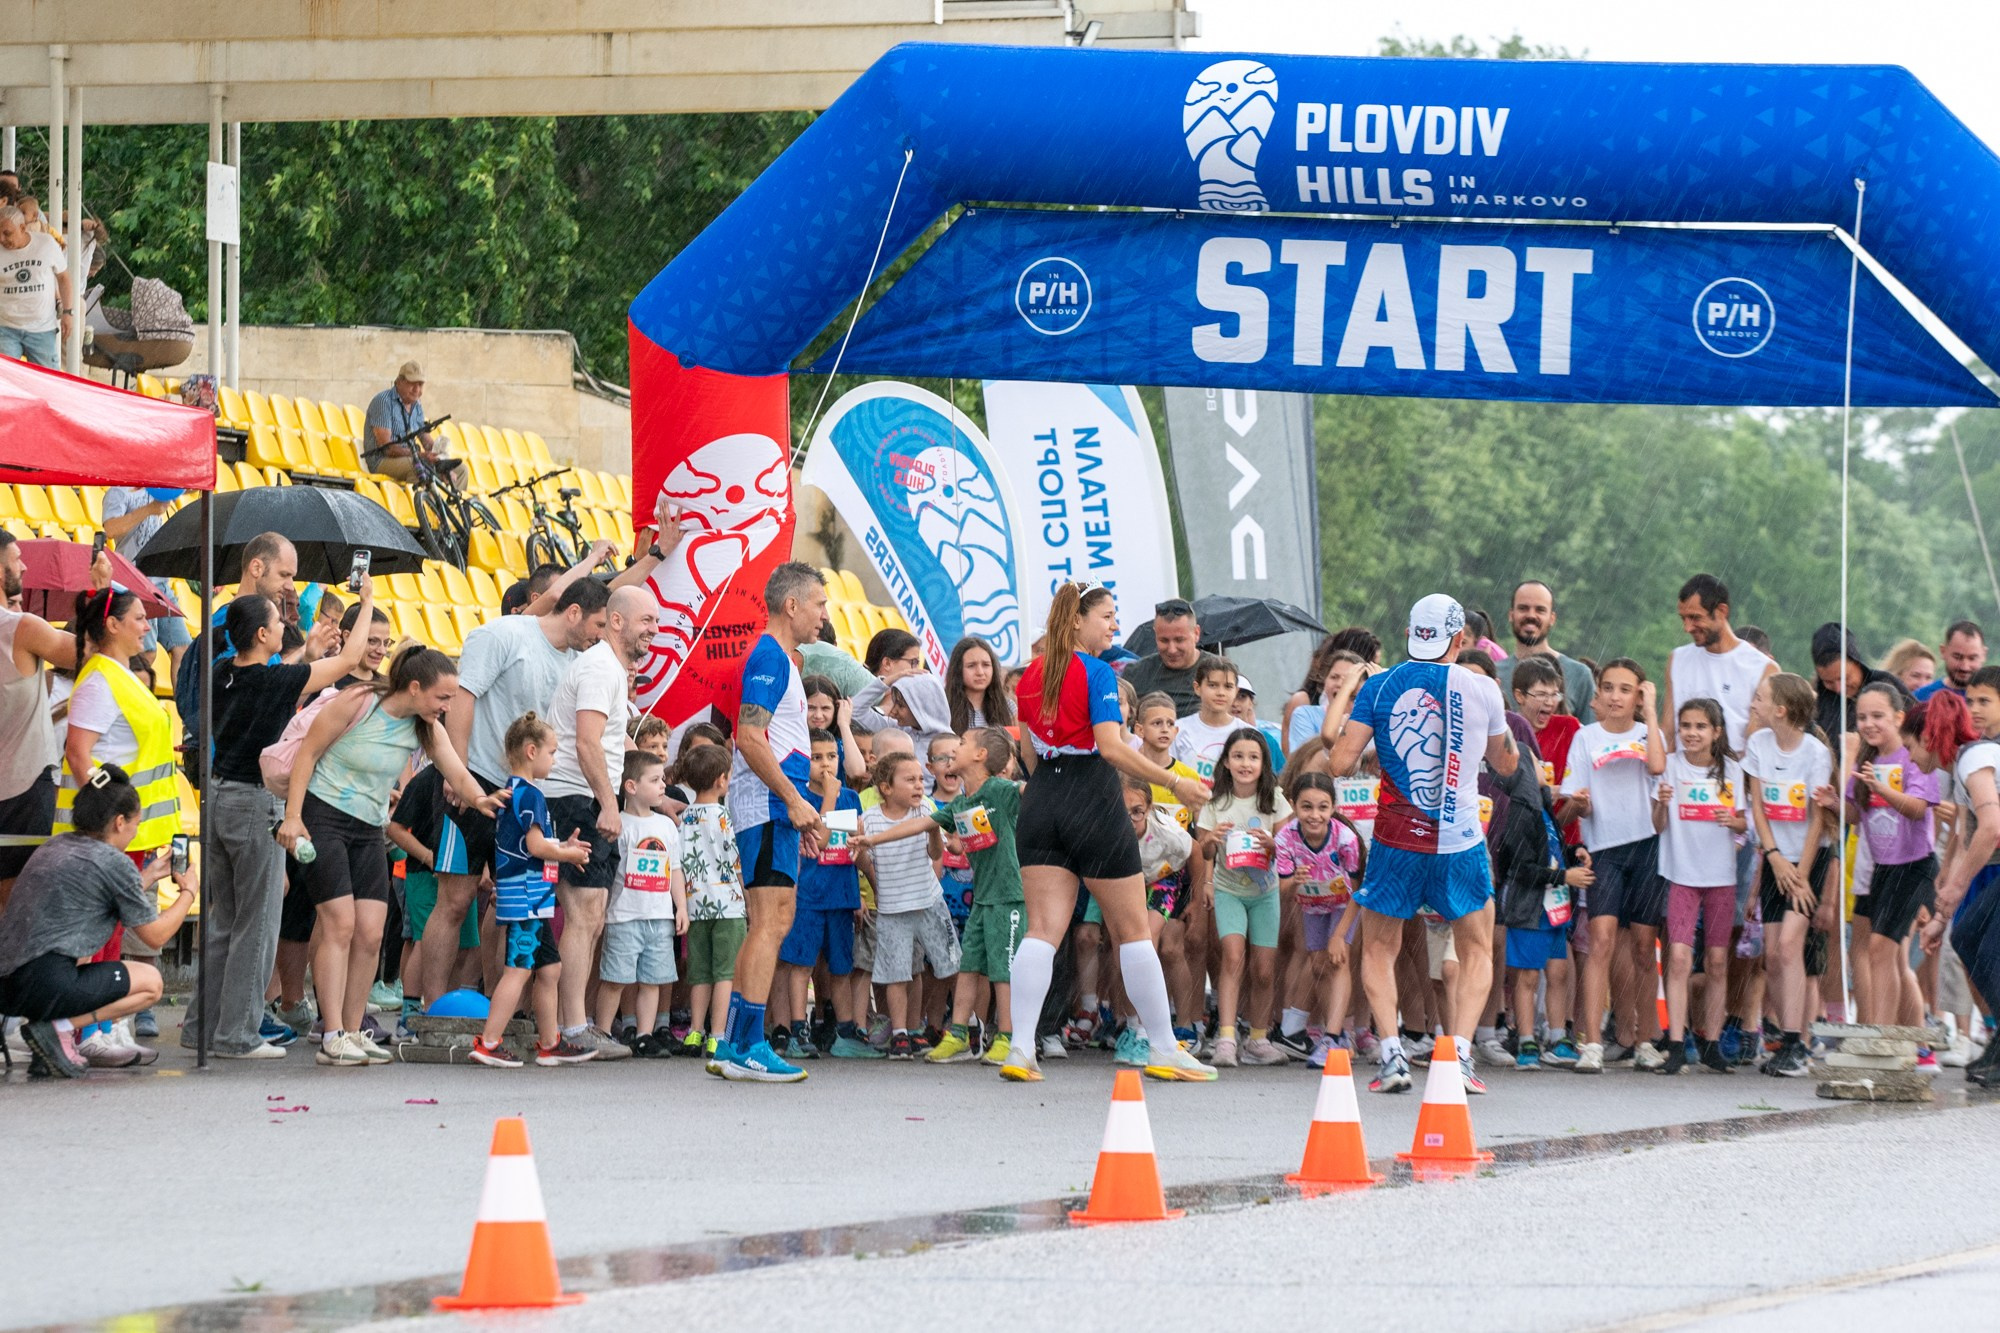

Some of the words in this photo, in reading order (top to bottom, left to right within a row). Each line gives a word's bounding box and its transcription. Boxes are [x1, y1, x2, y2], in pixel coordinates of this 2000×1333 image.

[1296, 102, 1510, 157] PLOVDIV
[1296, 165, 1434, 207] HILLS
[1449, 175, 1476, 189] IN
[1450, 193, 1588, 208] MARKOVO
[1028, 281, 1078, 307] P/H
[1191, 236, 1594, 376] START
[1707, 302, 1761, 329] P/H
[1707, 330, 1760, 338] MARKOVO
[1450, 690, 1464, 753] MATTERS
[1446, 753, 1461, 788] STEP
[1343, 788, 1369, 802] 108
[1688, 788, 1709, 802] 46
[637, 857, 660, 873] 82
